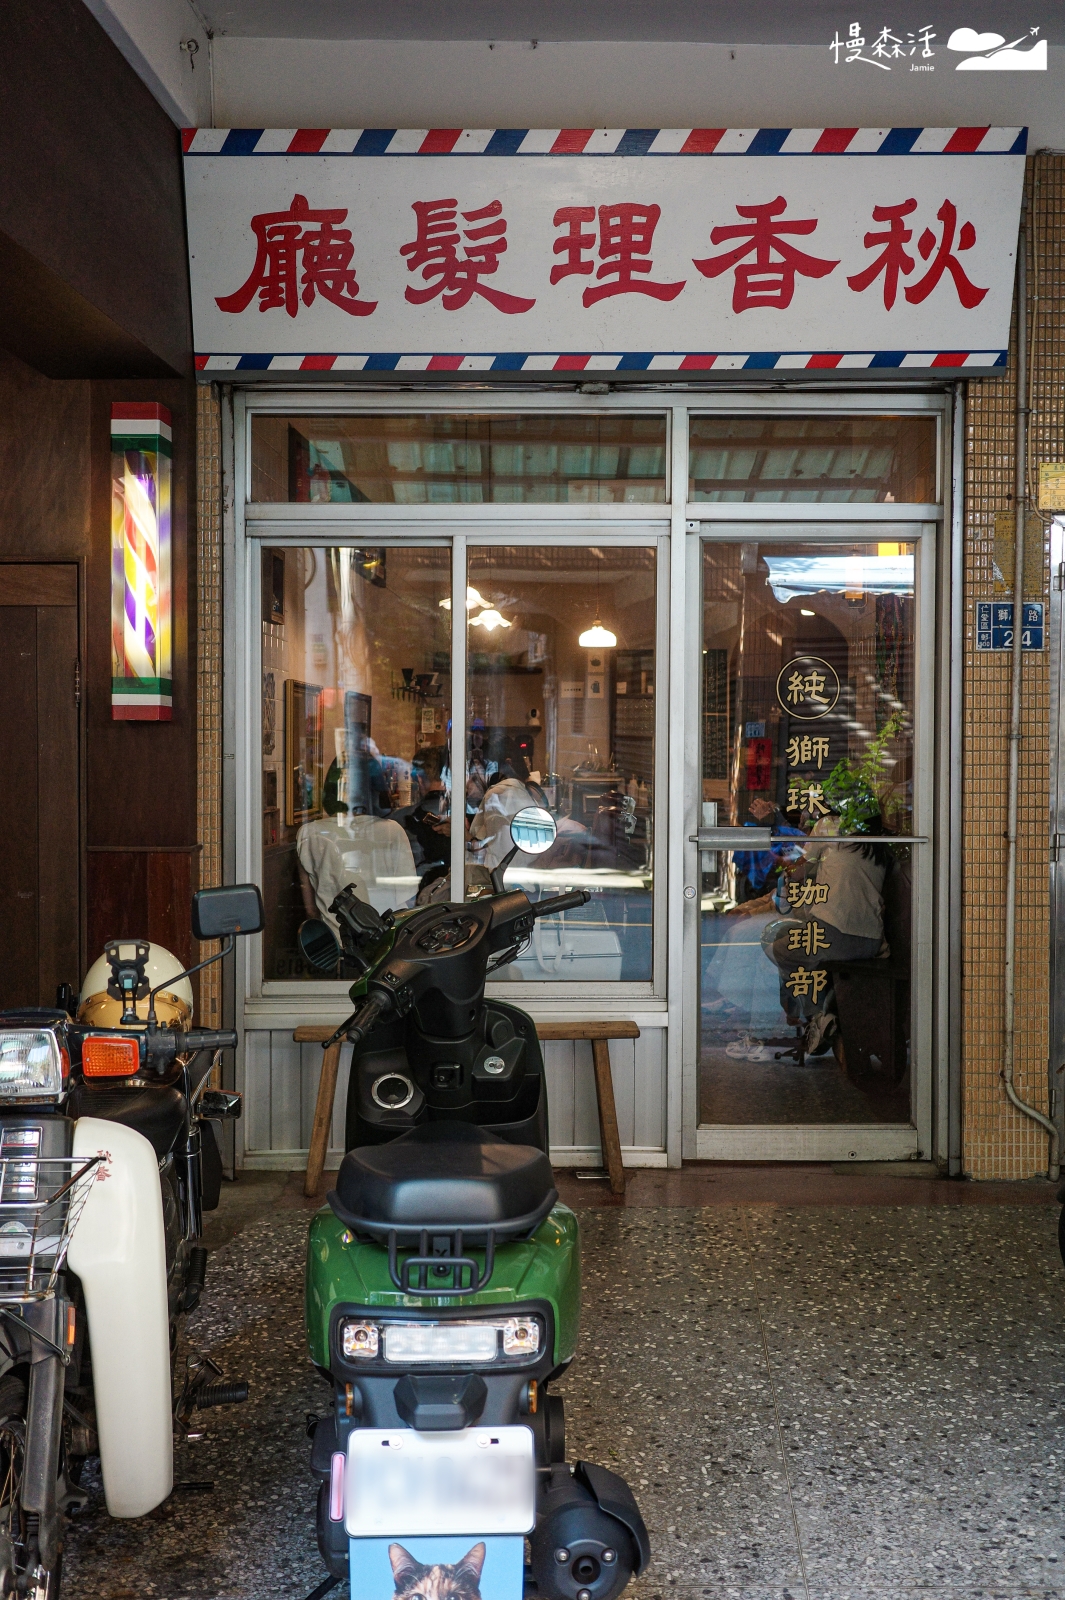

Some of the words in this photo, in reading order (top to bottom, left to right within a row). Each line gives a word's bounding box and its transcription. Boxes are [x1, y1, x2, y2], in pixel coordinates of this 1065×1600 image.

[215, 194, 989, 317] 秋香理髮廳
[997, 609, 1039, 622] 獅路
[1003, 630, 1032, 647] 24
